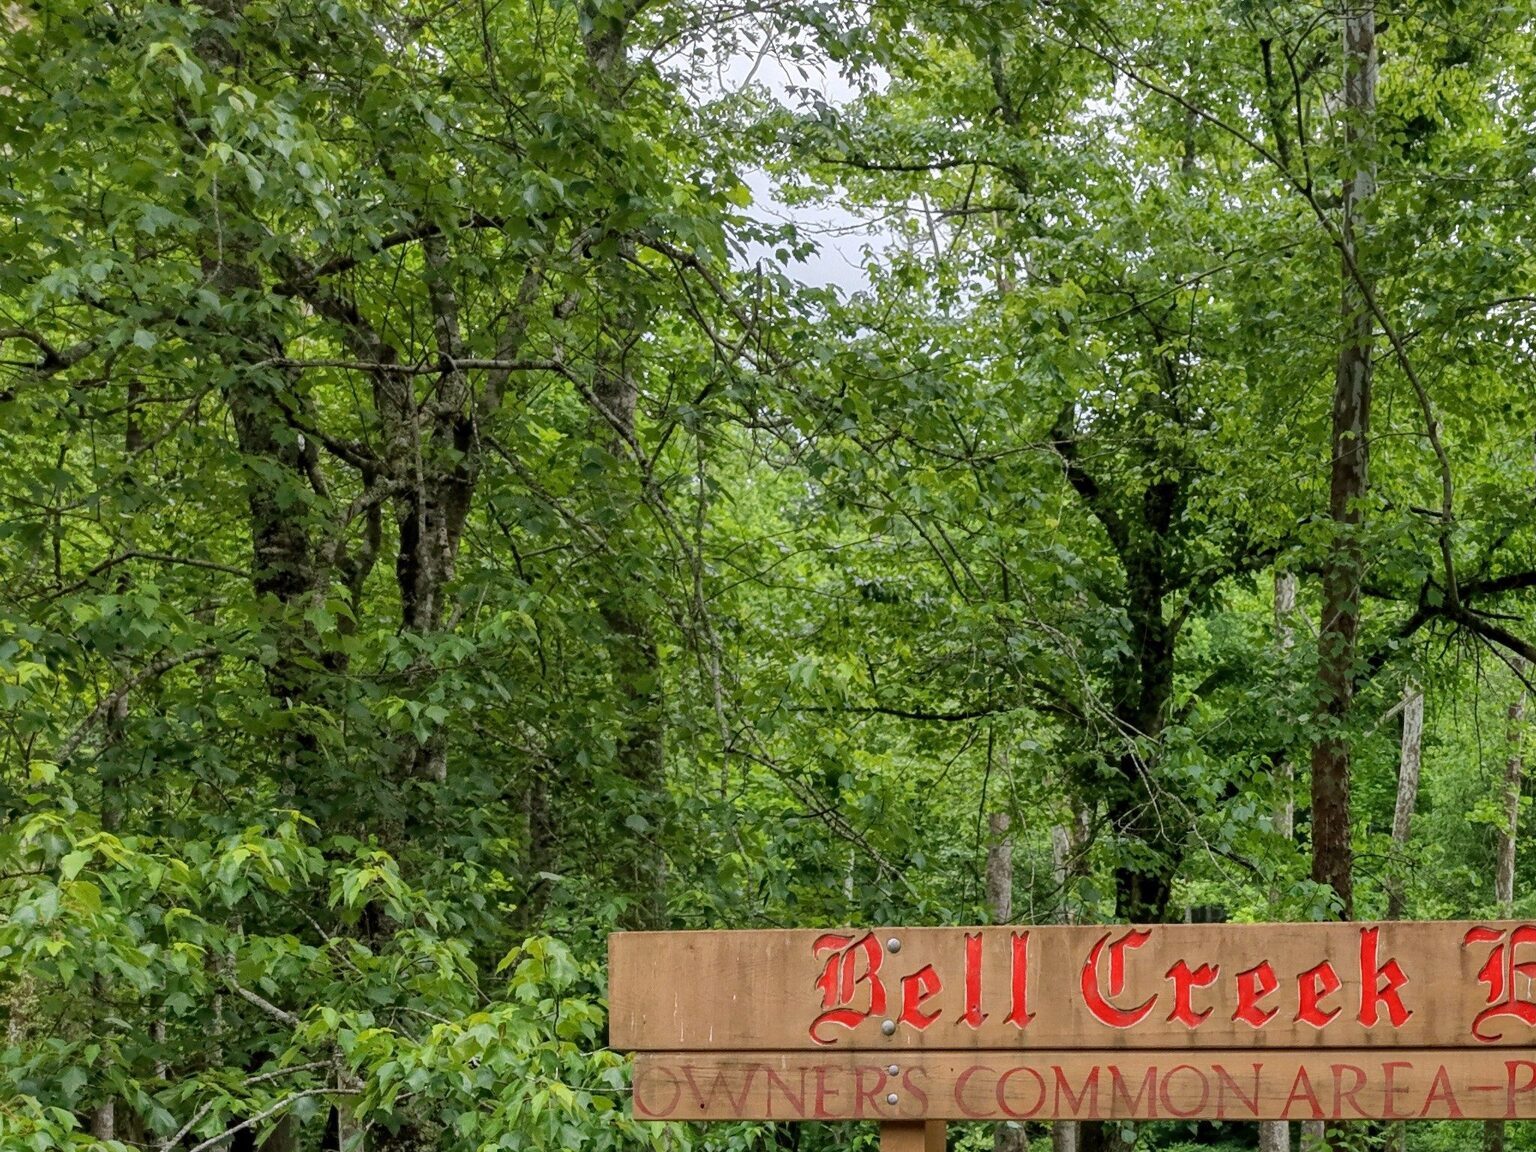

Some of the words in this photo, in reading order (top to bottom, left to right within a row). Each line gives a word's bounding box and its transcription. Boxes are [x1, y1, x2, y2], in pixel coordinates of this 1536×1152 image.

[809, 929, 1038, 1045] Bell
[1080, 926, 1414, 1030] Creek
[633, 1063, 930, 1119] OWNERS
[954, 1063, 1263, 1119] COMMON
